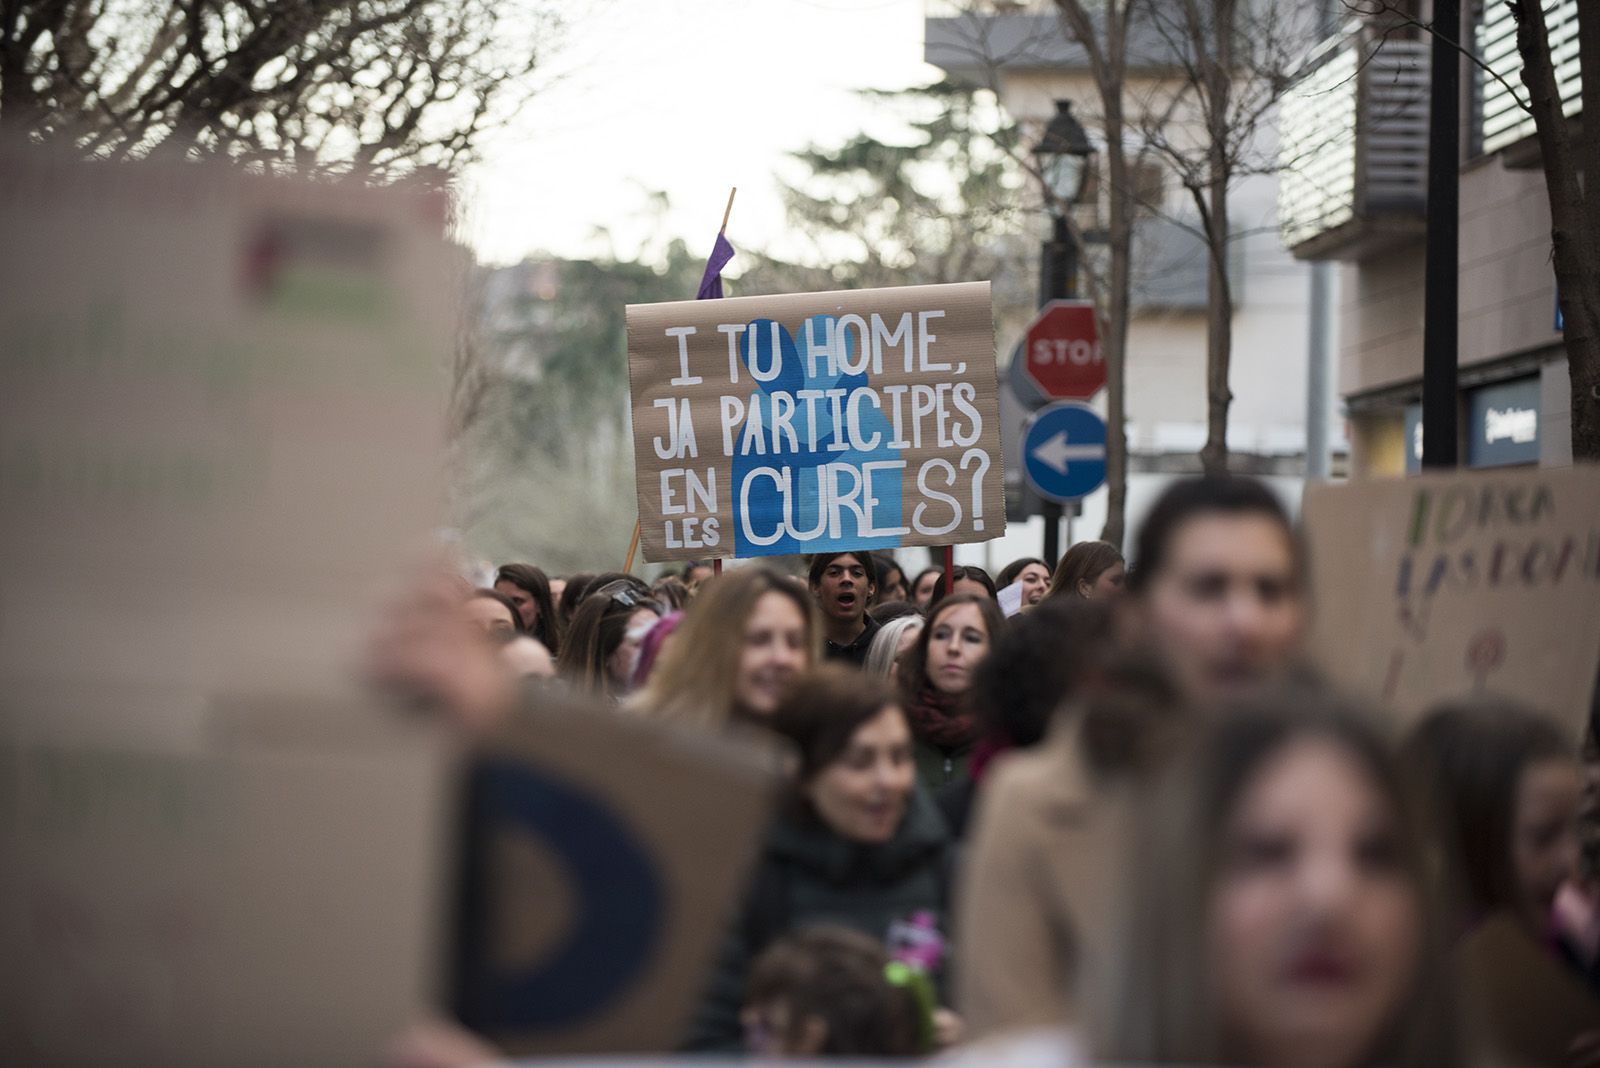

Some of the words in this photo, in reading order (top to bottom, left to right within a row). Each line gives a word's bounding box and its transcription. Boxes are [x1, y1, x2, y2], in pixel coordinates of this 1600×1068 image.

[664, 326, 703, 386] I
[717, 321, 783, 384] TU
[805, 310, 967, 378] HOME,
[653, 397, 698, 460] JA
[720, 382, 983, 456] PARTICIPES
[660, 467, 717, 515] EN
[665, 518, 721, 548] LES
